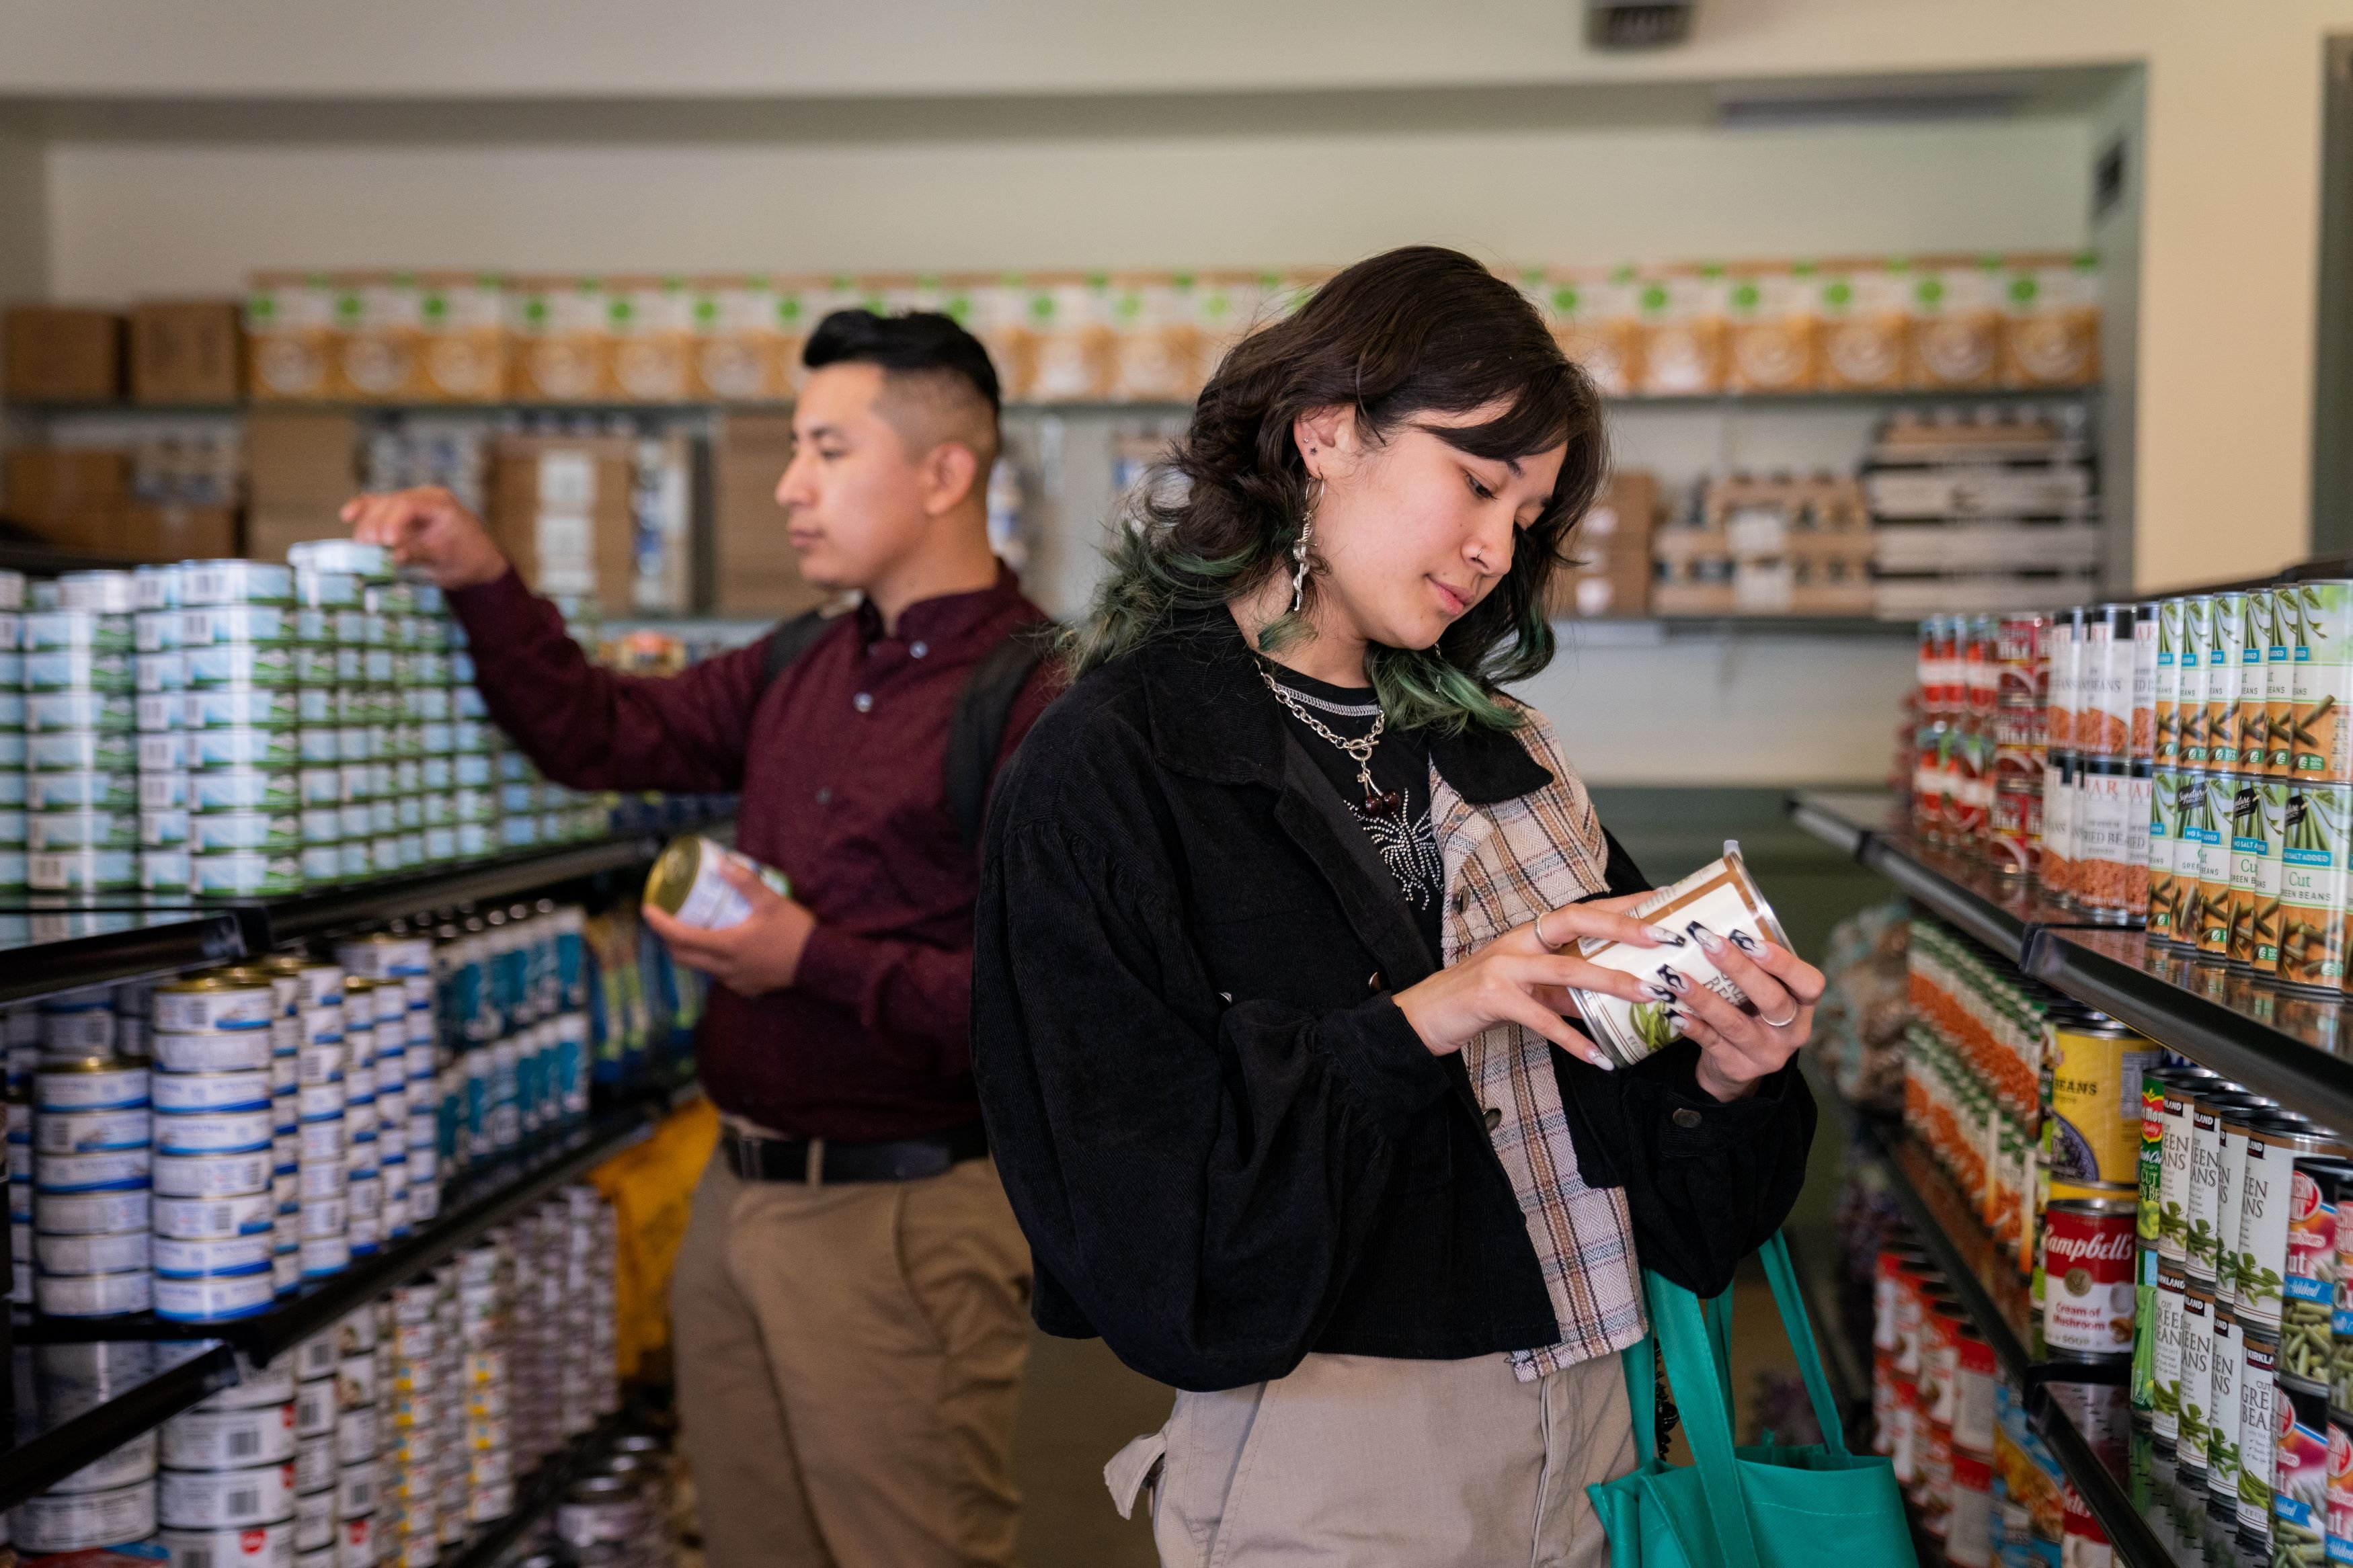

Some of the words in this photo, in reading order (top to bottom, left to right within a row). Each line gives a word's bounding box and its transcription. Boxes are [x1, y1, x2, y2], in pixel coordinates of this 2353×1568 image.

[2292, 688, 2307, 696] EANS
[2182, 862, 2200, 871] GREE
[2241, 859, 2257, 872] Cu
[2302, 854, 2329, 862] ADDED
[2288, 871, 2312, 887] Cut
[2299, 891, 2332, 901] BEANS
[2163, 1132, 2190, 1153] EEN
[2161, 1151, 2186, 1171] ANS
[2192, 1145, 2219, 1168] EEN
[2141, 1167, 2157, 1185] CUT
[2190, 1166, 2217, 1188] ANS
[2244, 1175, 2269, 1199] EEN
[2288, 1252, 2306, 1275] ut
[2056, 1301, 2086, 1317] Cream
[2089, 1307, 2102, 1318] of
[2157, 1307, 2183, 1329] REE
[2052, 1313, 2106, 1331] Mushroom
[2062, 1335, 2089, 1346] SOUP
[2156, 1325, 2182, 1348] EAN
[2184, 1331, 2211, 1355] EEN
[2182, 1350, 2207, 1372] ANS
[2256, 1380, 2272, 1392] CUT
[2242, 1385, 2269, 1410] GRE
[2242, 1404, 2271, 1432] BEA
